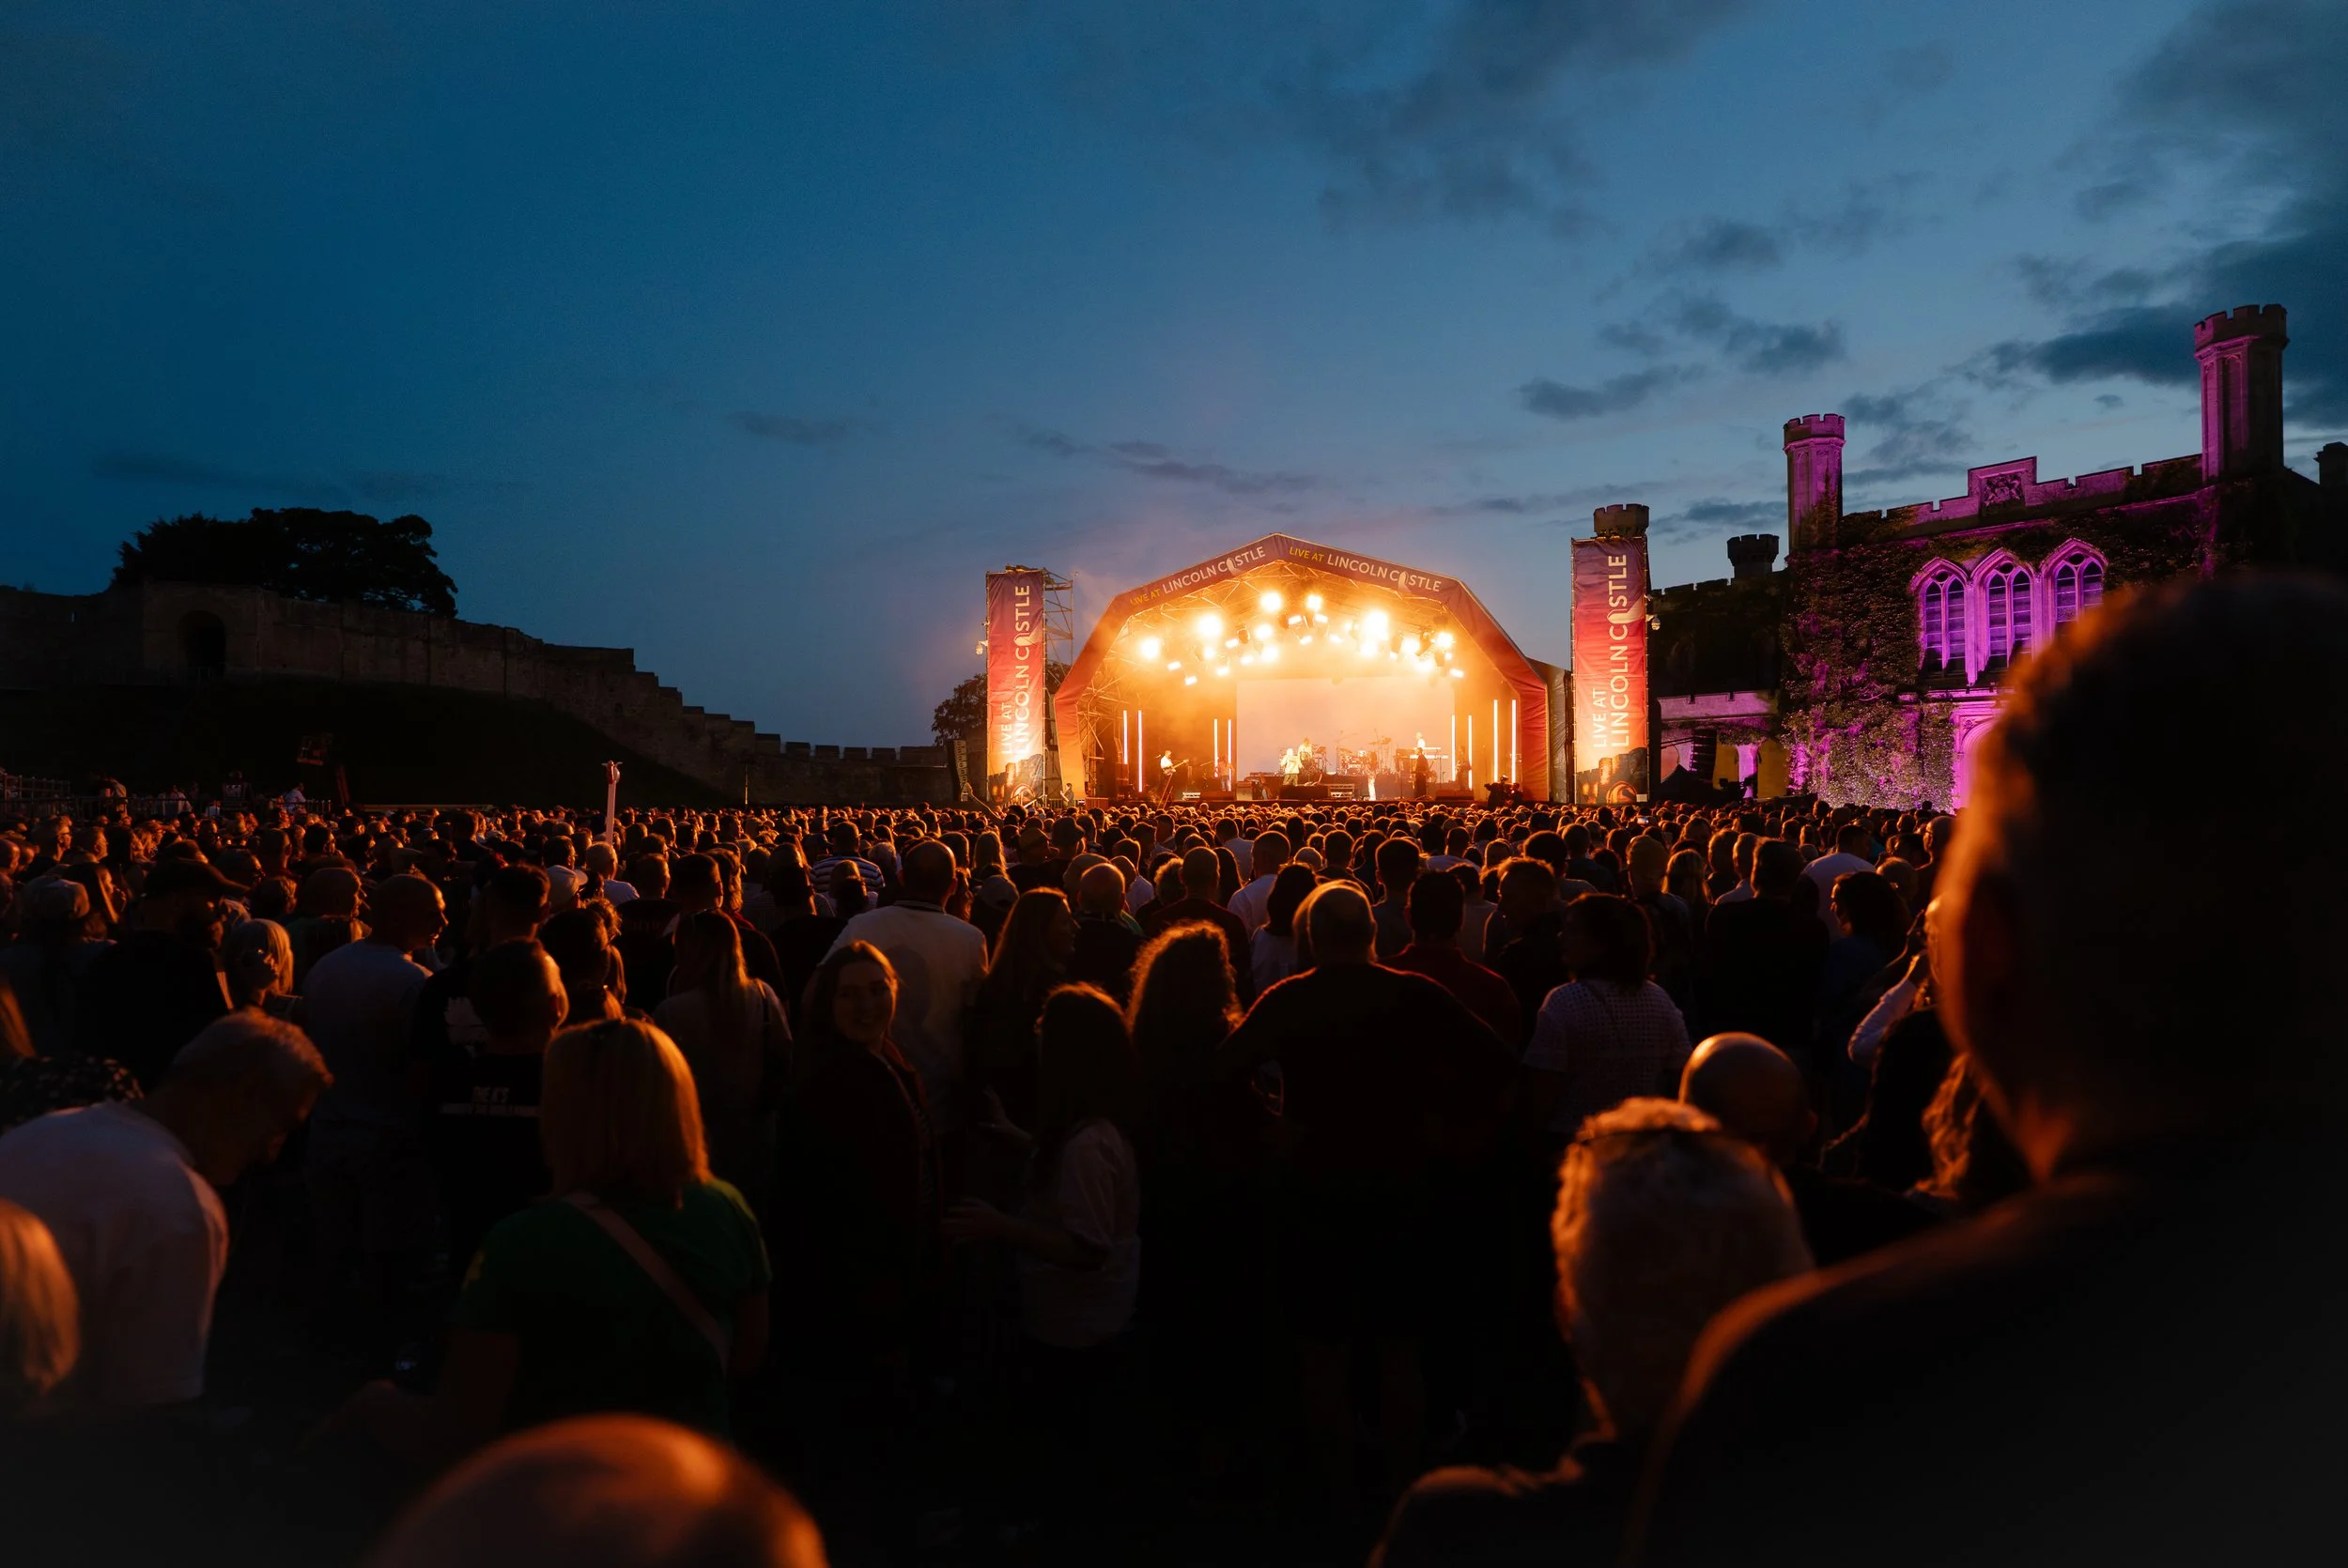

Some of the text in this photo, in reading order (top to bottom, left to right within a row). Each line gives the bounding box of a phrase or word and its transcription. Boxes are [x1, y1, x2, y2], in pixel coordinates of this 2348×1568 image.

[1130, 592, 1149, 606] LIVE
[1150, 589, 1161, 600] AT
[1162, 565, 1217, 594] LINCOLN
[1290, 546, 1310, 560] LIVE
[1311, 552, 1324, 562] AT
[1327, 554, 1388, 579] LINCOLN
[1015, 665, 1030, 755] LINCOLN
[1592, 687, 1607, 747] LIVE AT
[1609, 645, 1630, 747] LINCOLN
[1001, 701, 1012, 755] LIVE AT
